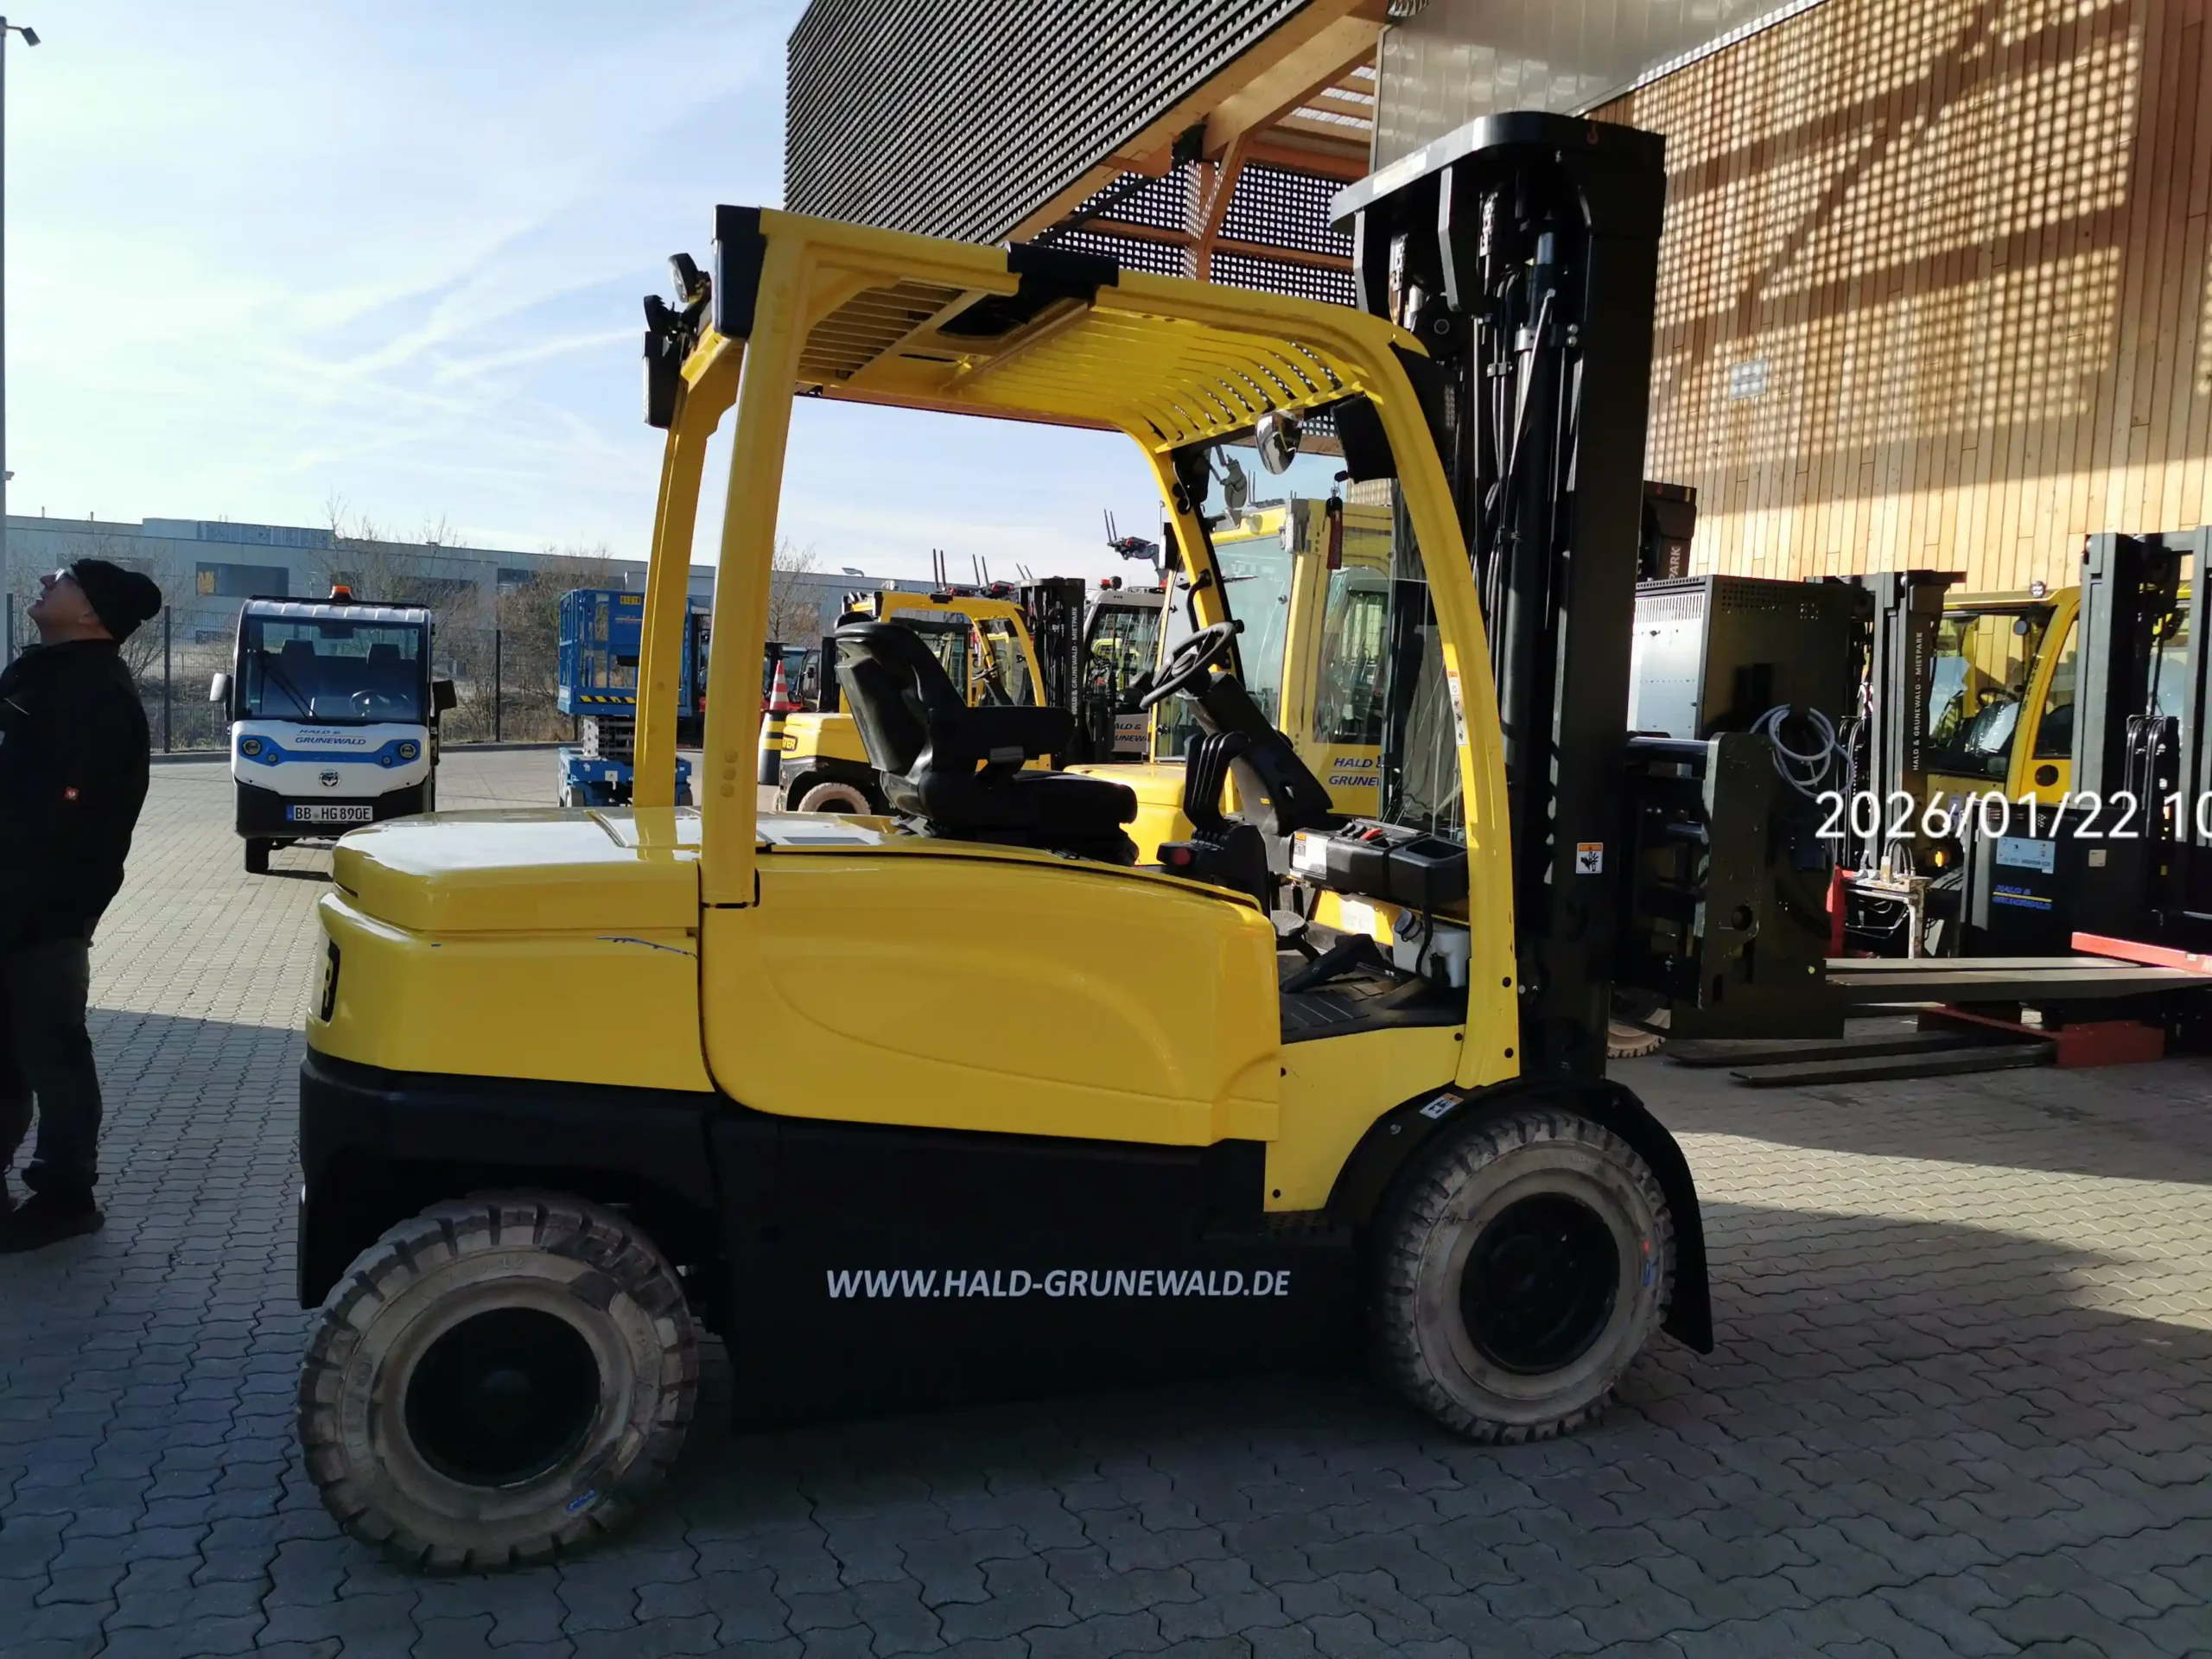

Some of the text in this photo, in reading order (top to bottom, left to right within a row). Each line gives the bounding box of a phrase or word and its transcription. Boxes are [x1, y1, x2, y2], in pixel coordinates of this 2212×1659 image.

[1913, 683, 1922, 736] GRUNEWALD
[295, 736, 366, 746] GRUNEWALD
[1333, 757, 1373, 768] HALD
[1329, 775, 1380, 786] GRUNE
[296, 807, 311, 819] BB
[826, 1269, 1291, 1298] WWW.HALD-GRUNEWALD.DE
